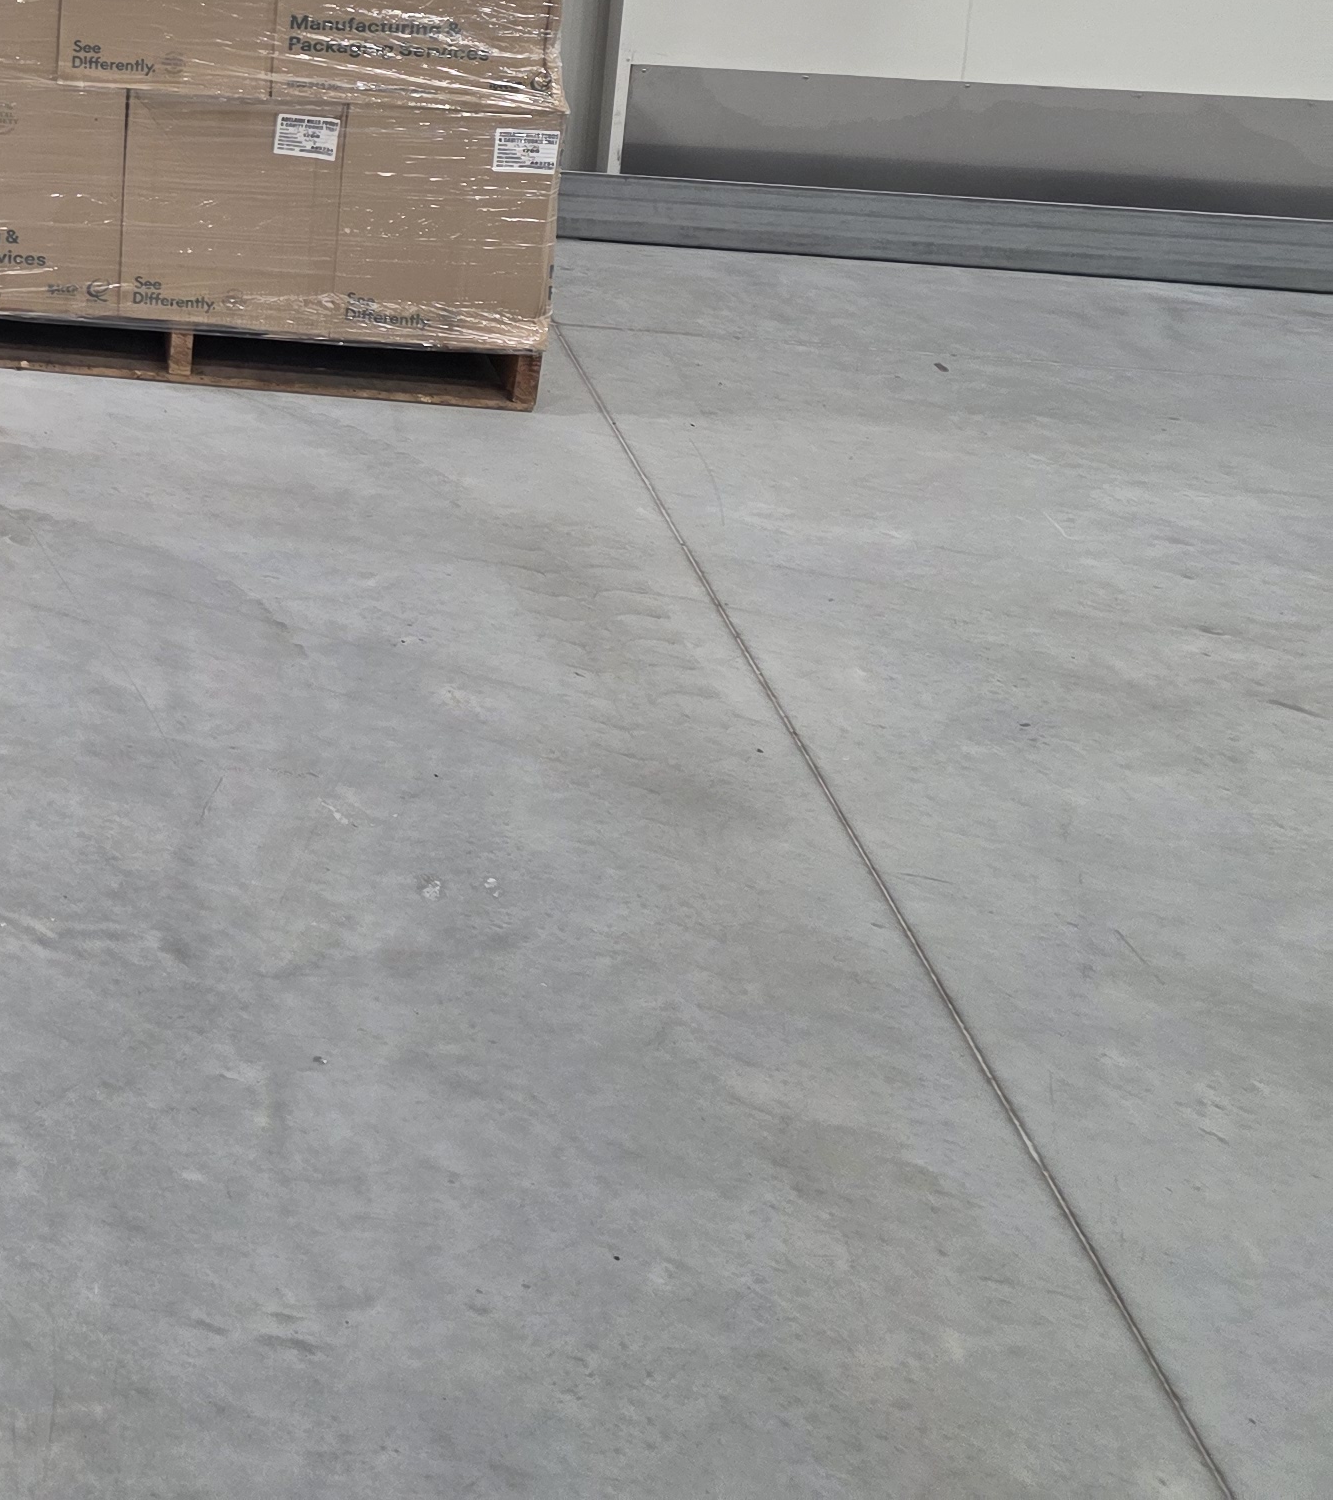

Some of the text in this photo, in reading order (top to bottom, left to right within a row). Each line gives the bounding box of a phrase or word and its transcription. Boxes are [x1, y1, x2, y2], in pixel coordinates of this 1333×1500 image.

[290, 14, 462, 37] Manufacturing &
[73, 40, 101, 53] See
[288, 36, 489, 61] Packaging Services
[6, 229, 19, 244] &
[134, 276, 161, 291] See
[347, 291, 375, 306] See
